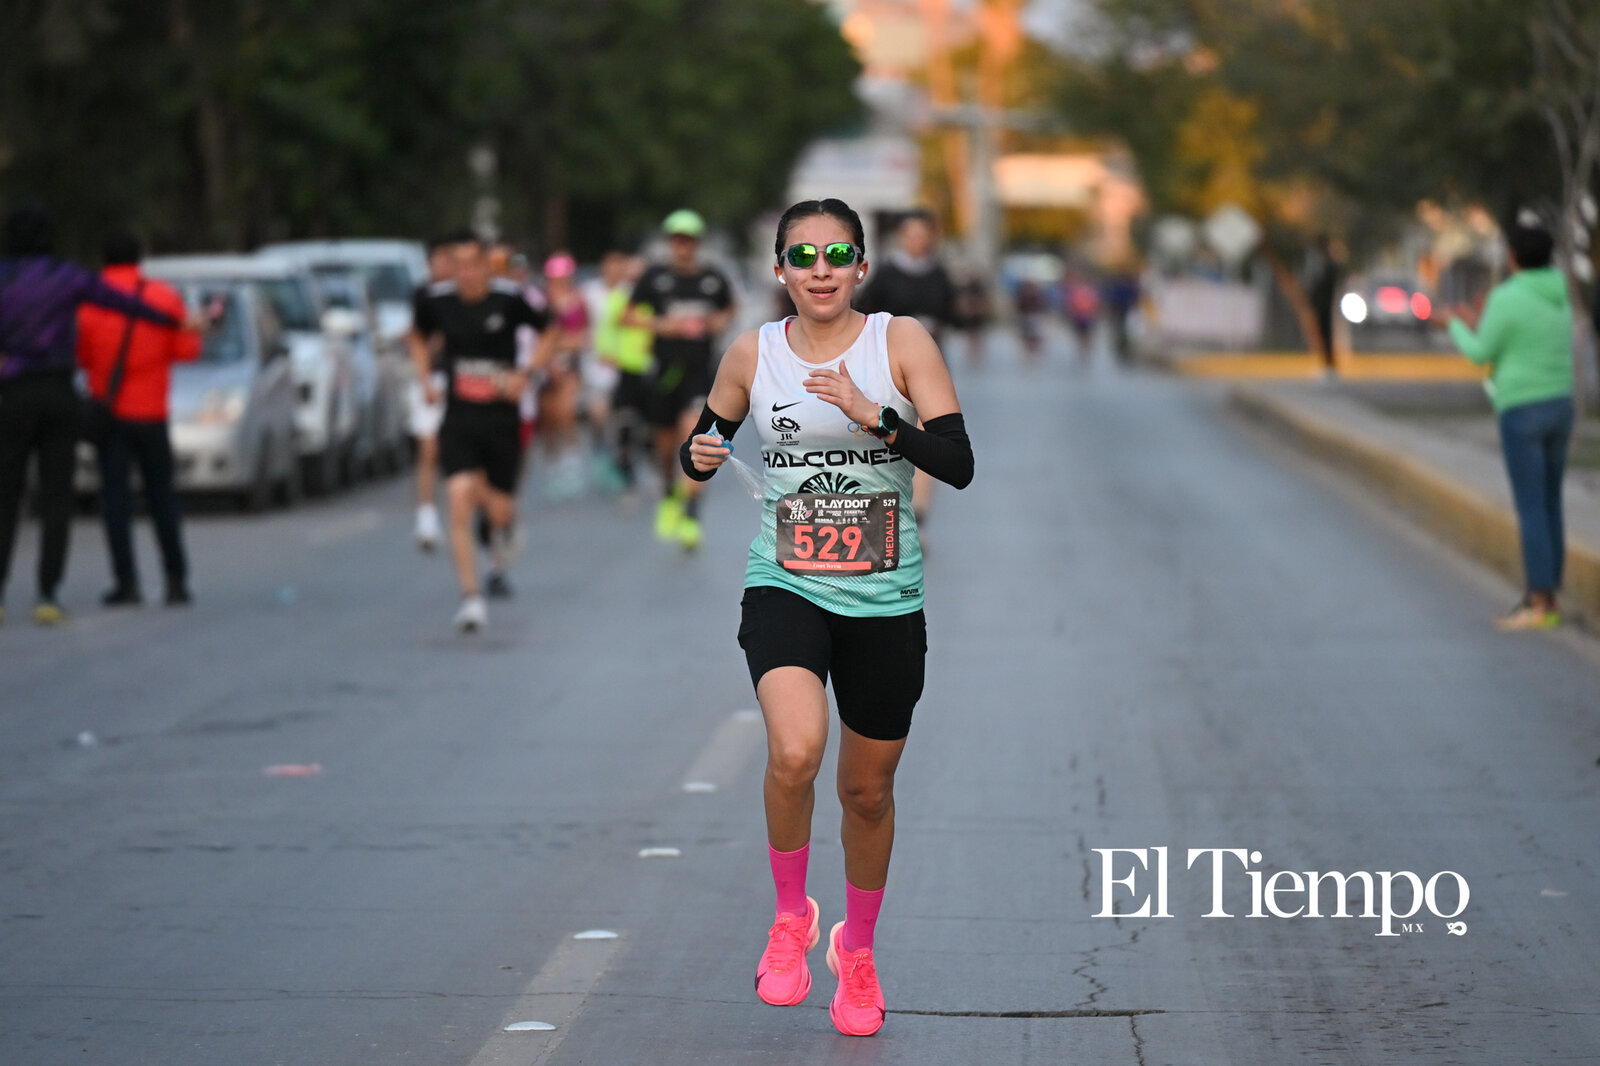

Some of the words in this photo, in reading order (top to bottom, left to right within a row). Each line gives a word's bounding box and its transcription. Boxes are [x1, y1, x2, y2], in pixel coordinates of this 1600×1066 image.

[780, 433, 793, 441] JR
[814, 498, 871, 509] PLAYDOIT
[882, 498, 897, 507] 529
[789, 510, 806, 520] 5K
[885, 509, 895, 558] MEDALLA
[793, 524, 862, 560] 529
